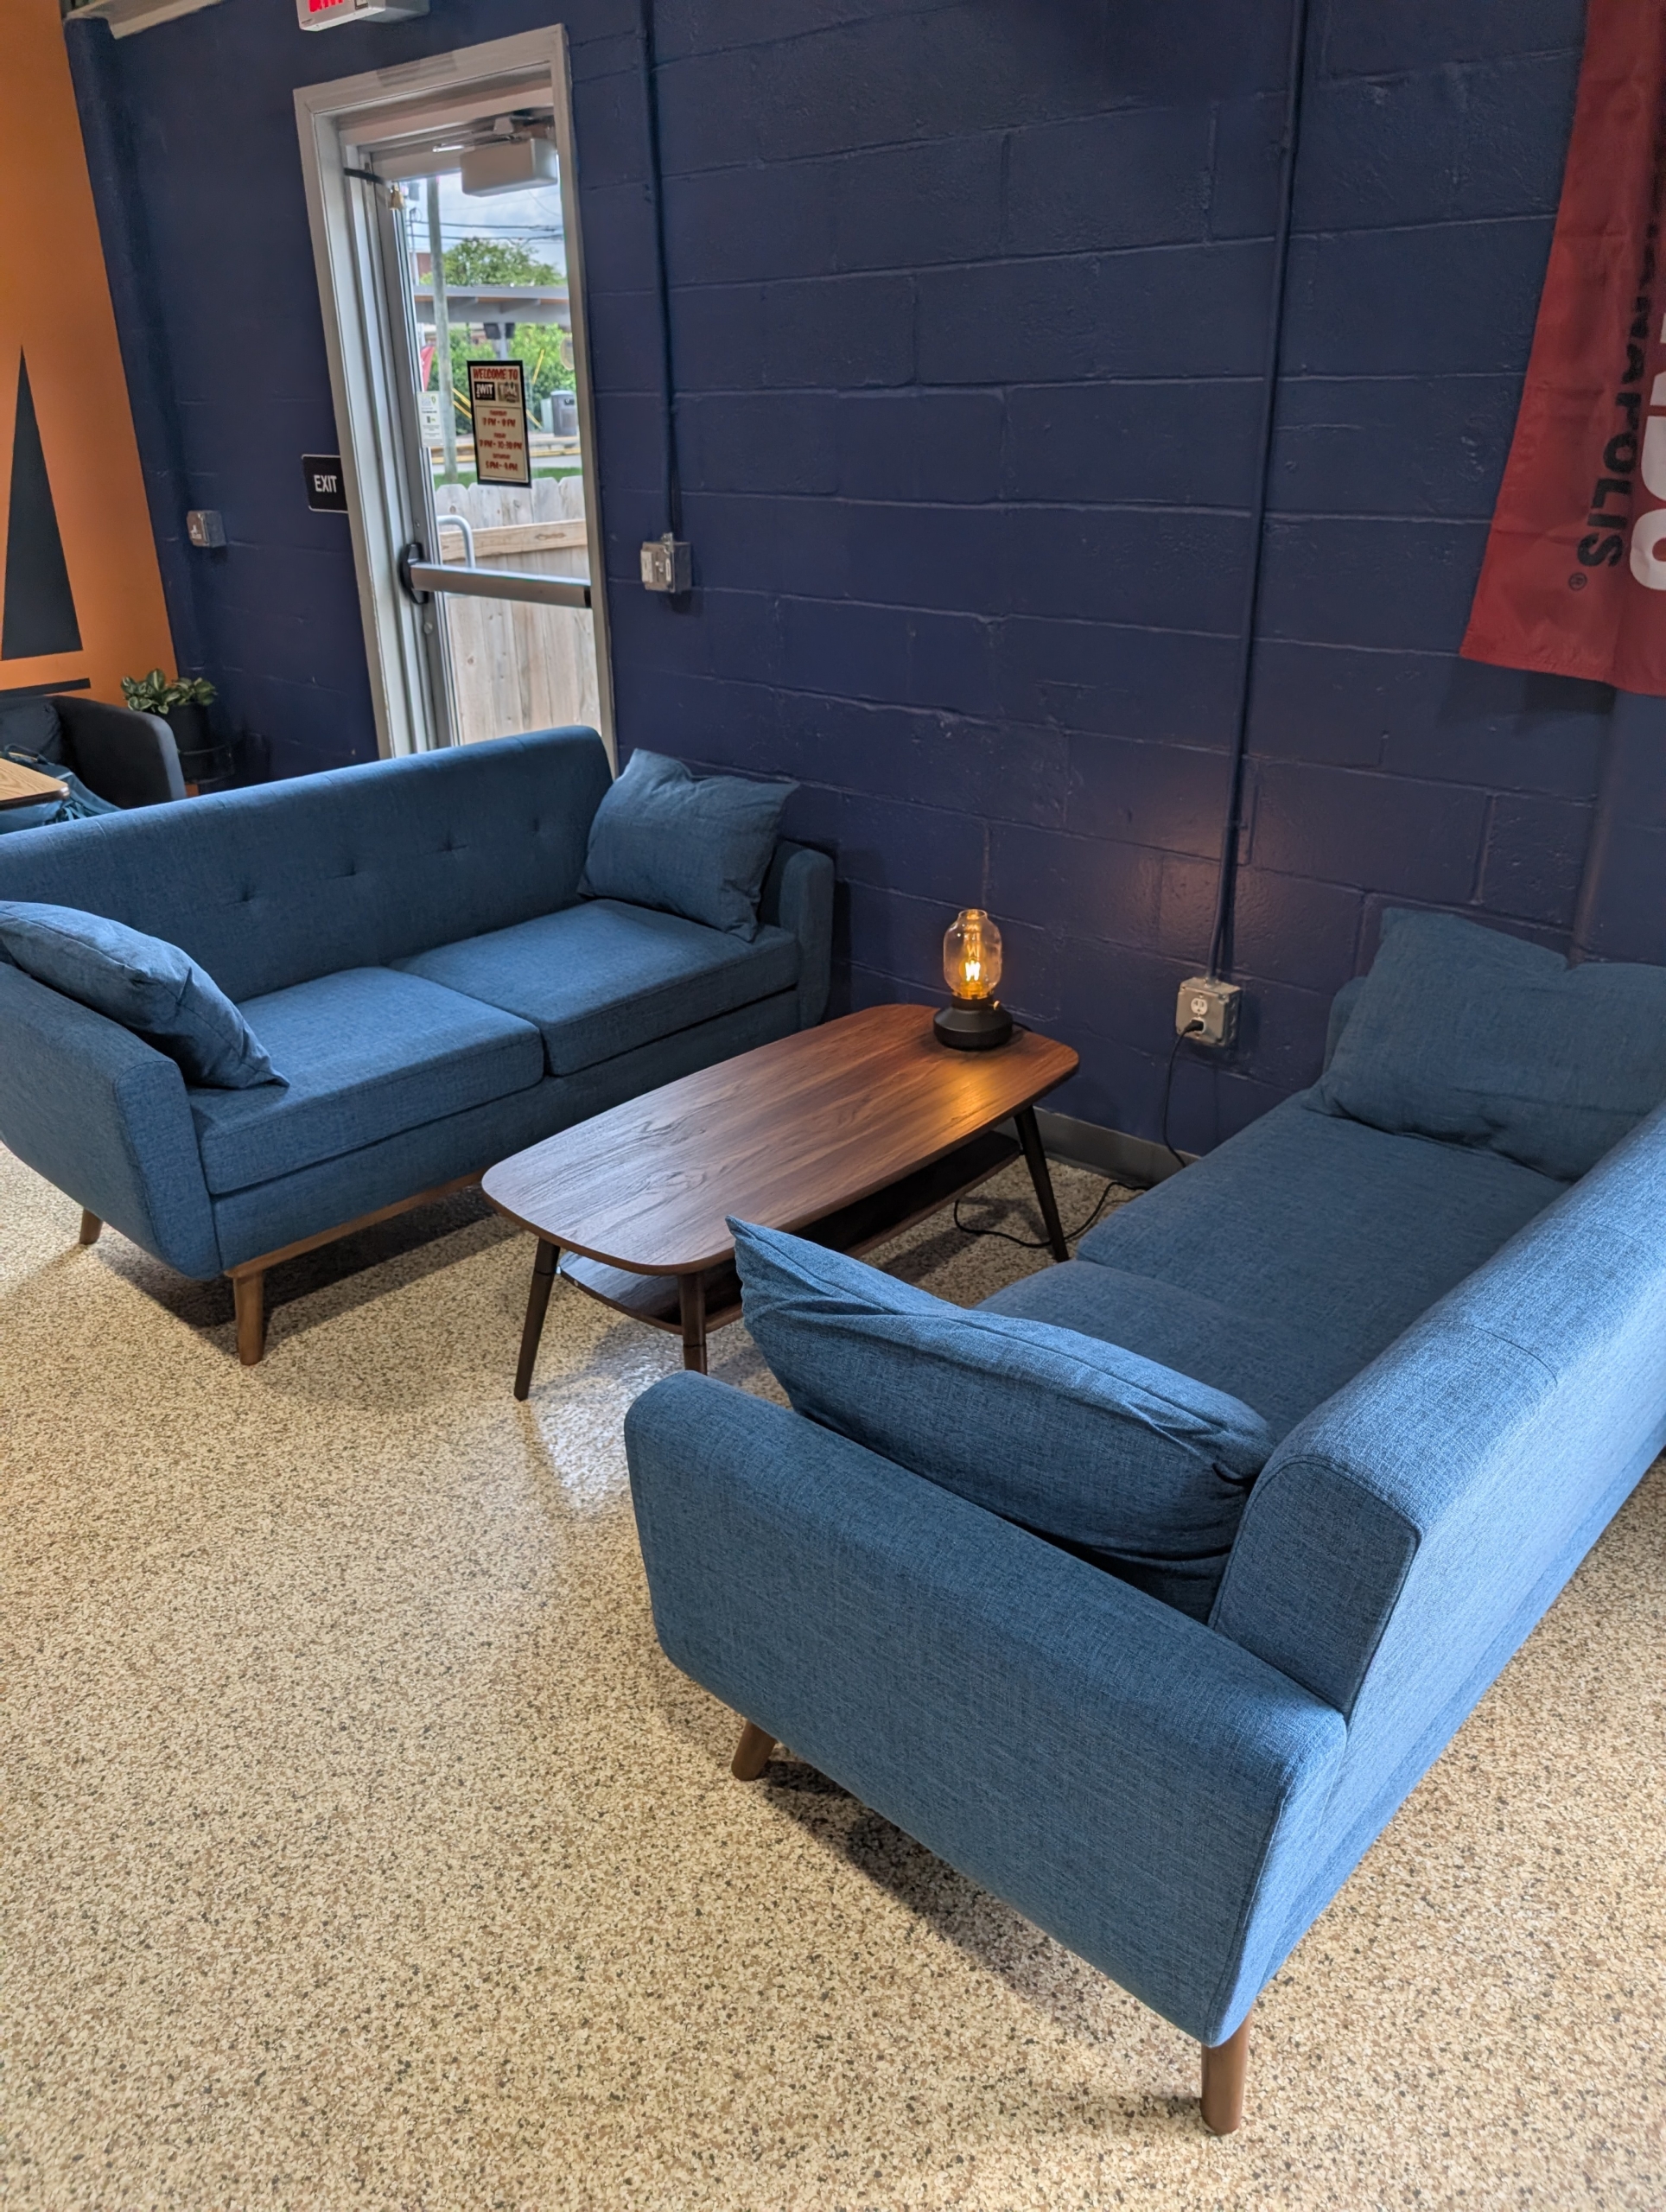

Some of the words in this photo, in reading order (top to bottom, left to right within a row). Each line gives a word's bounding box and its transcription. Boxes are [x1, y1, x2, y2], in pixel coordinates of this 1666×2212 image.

[473, 368, 506, 379] WELCOME
[508, 368, 518, 380] TO
[314, 474, 337, 493] EXIT
